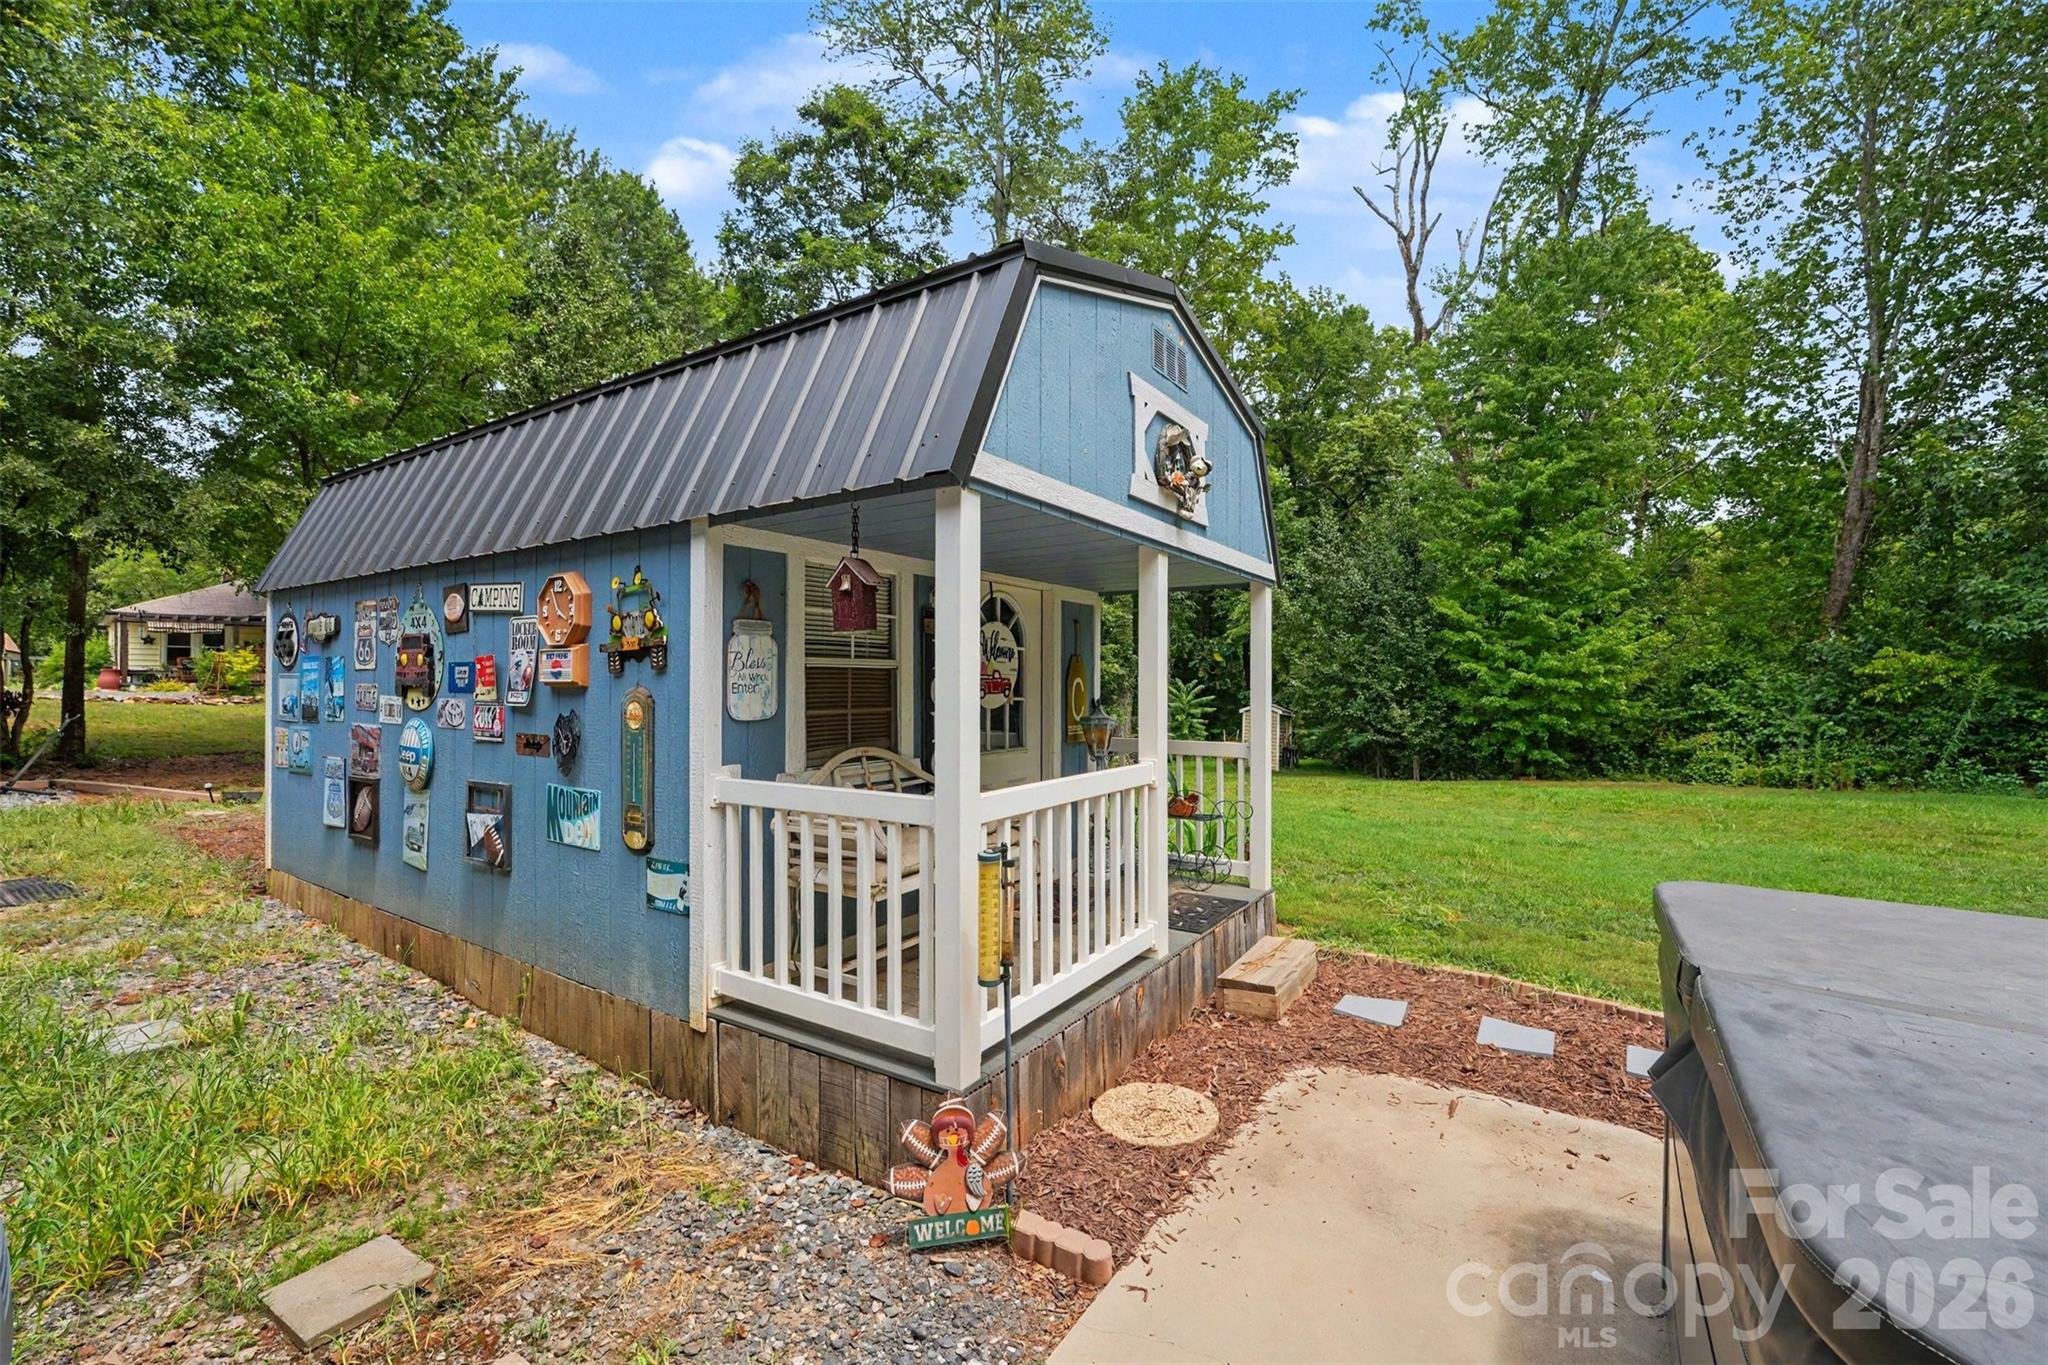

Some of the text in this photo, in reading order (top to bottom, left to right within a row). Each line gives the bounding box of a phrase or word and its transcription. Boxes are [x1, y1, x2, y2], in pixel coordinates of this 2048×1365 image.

[554, 581, 562, 592] 12
[471, 587, 519, 608] CAMPING
[410, 616, 427, 629] 4X4
[357, 640, 371, 661] 66
[512, 636, 536, 651] ROOM
[731, 648, 766, 671] Bless
[731, 682, 759, 694] Enter
[1072, 677, 1085, 721] C
[914, 1211, 1005, 1242] WELCOME
